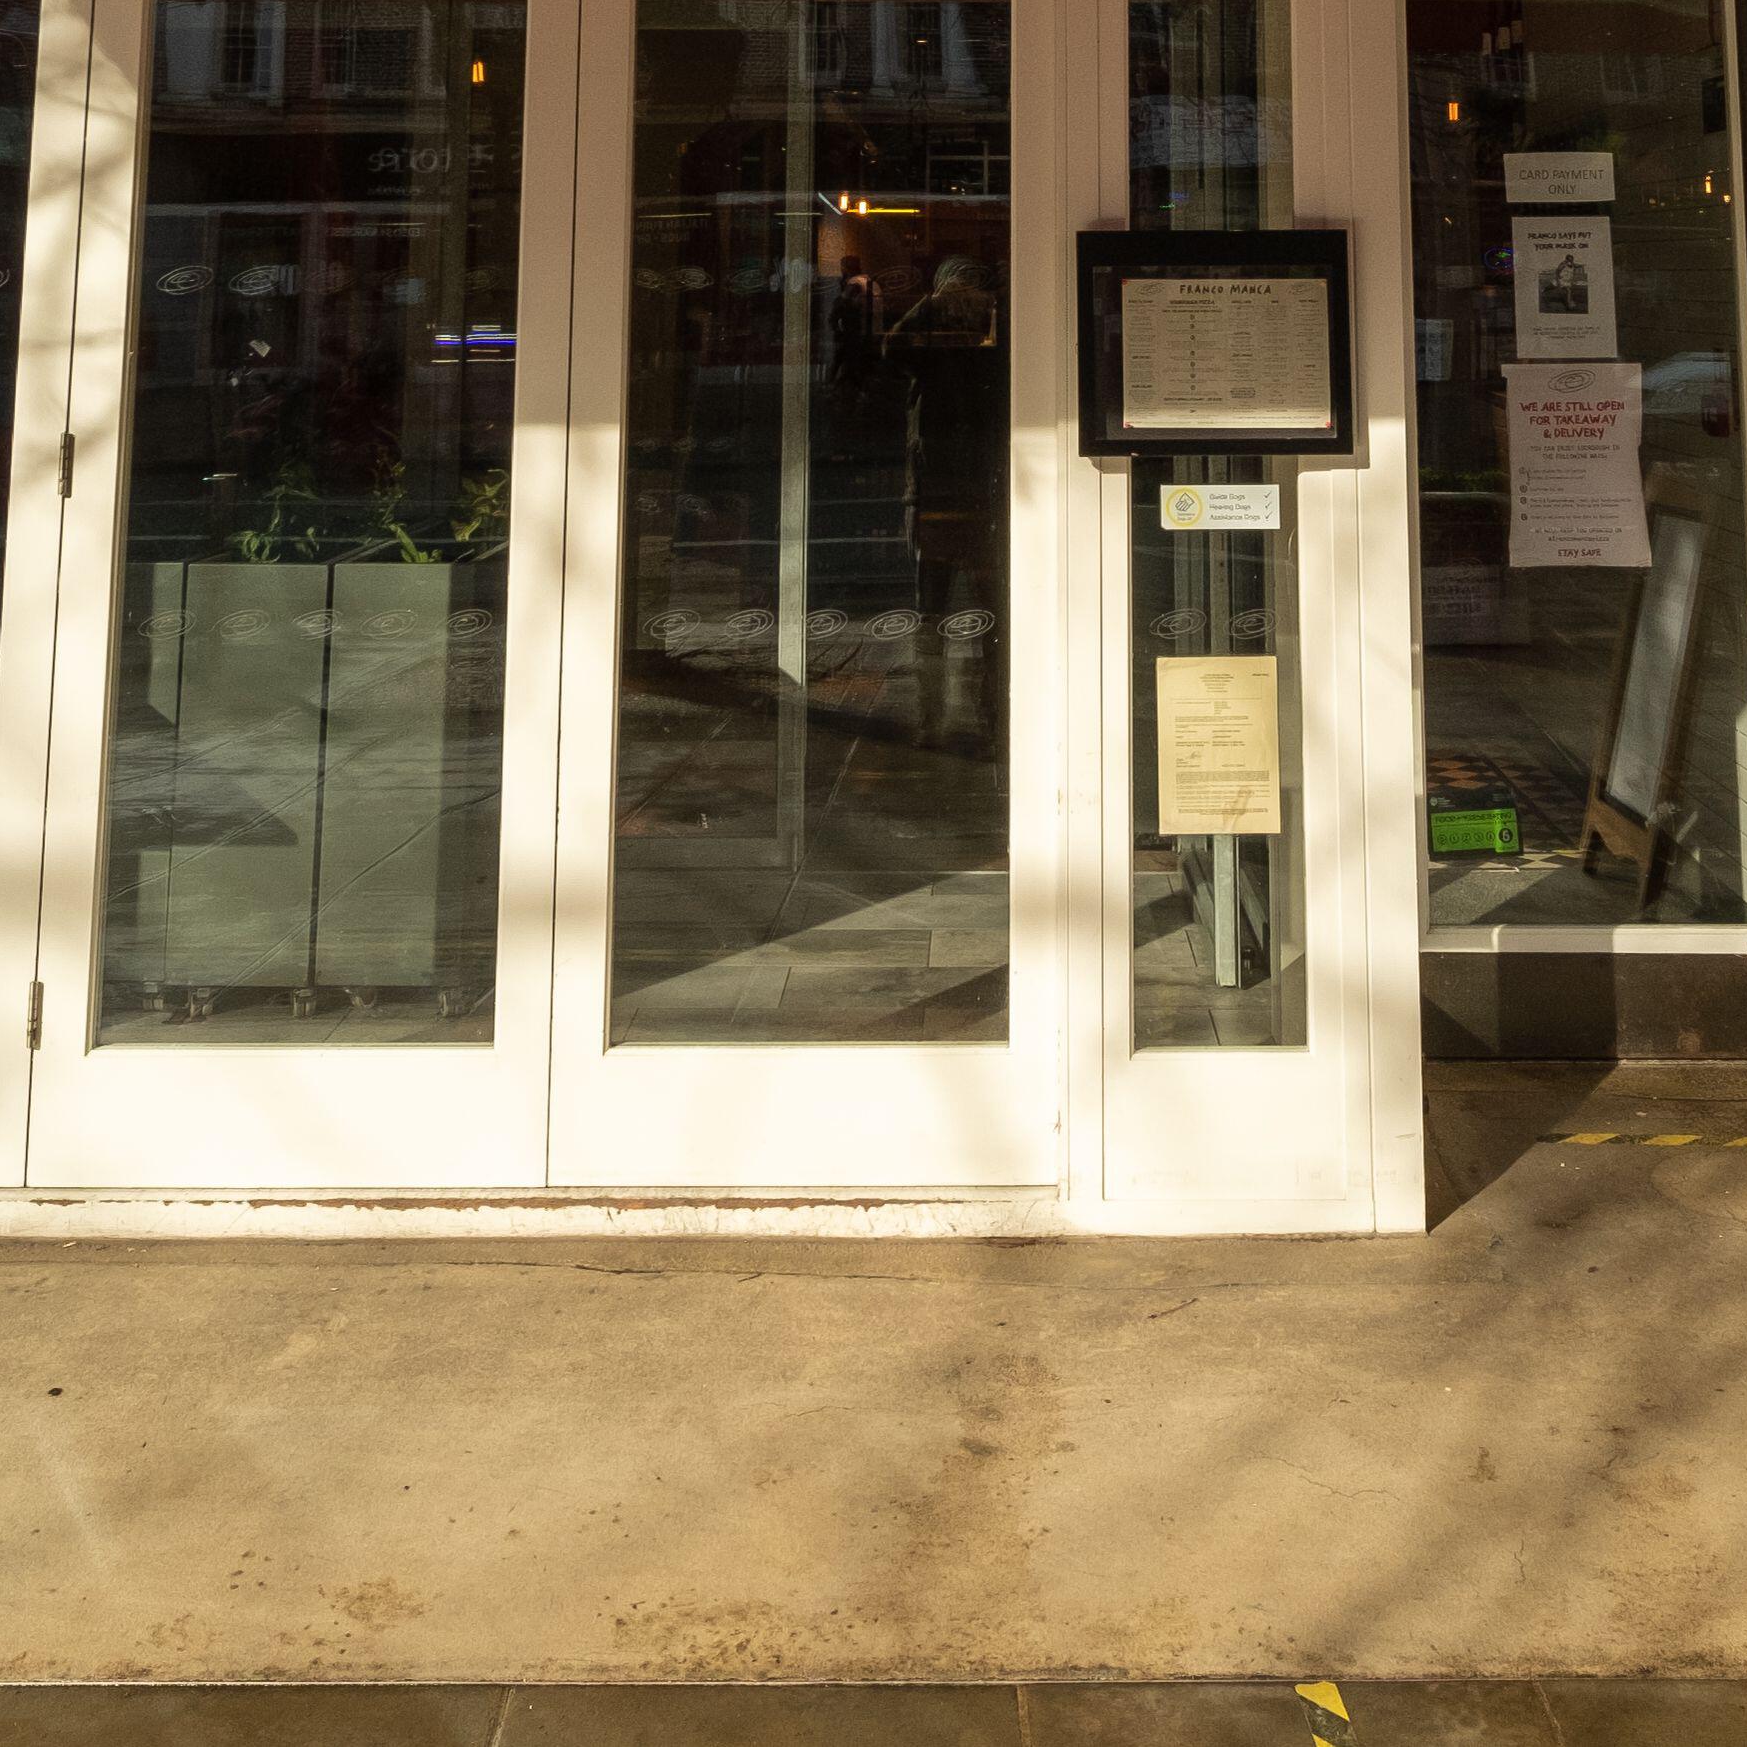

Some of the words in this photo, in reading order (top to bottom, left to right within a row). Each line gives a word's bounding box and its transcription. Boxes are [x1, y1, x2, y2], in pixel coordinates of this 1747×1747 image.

[1519, 169, 1549, 181] CARD
[1552, 169, 1604, 181] PAYMENT
[1548, 184, 1577, 196] ONLY
[1179, 285, 1224, 295] FRANCO
[1230, 285, 1272, 295] MANCA
[1519, 402, 1538, 412] WE
[1541, 402, 1562, 412] ARE
[1565, 402, 1594, 412] STILL
[1597, 400, 1625, 412] OPEN
[1529, 415, 1551, 426] FOR
[1555, 414, 1618, 427] TAKEAWAY
[1543, 430, 1552, 439] &
[1554, 428, 1605, 441] DELIVERY
[1208, 493, 1228, 501] Guide
[1229, 493, 1246, 502] Dogs
[1208, 504, 1234, 512] Hearing
[1235, 504, 1252, 512] Dogs
[1244, 514, 1261, 522] Dogs
[1557, 548, 1579, 558] STAY
[1581, 548, 1602, 558] SAFE
